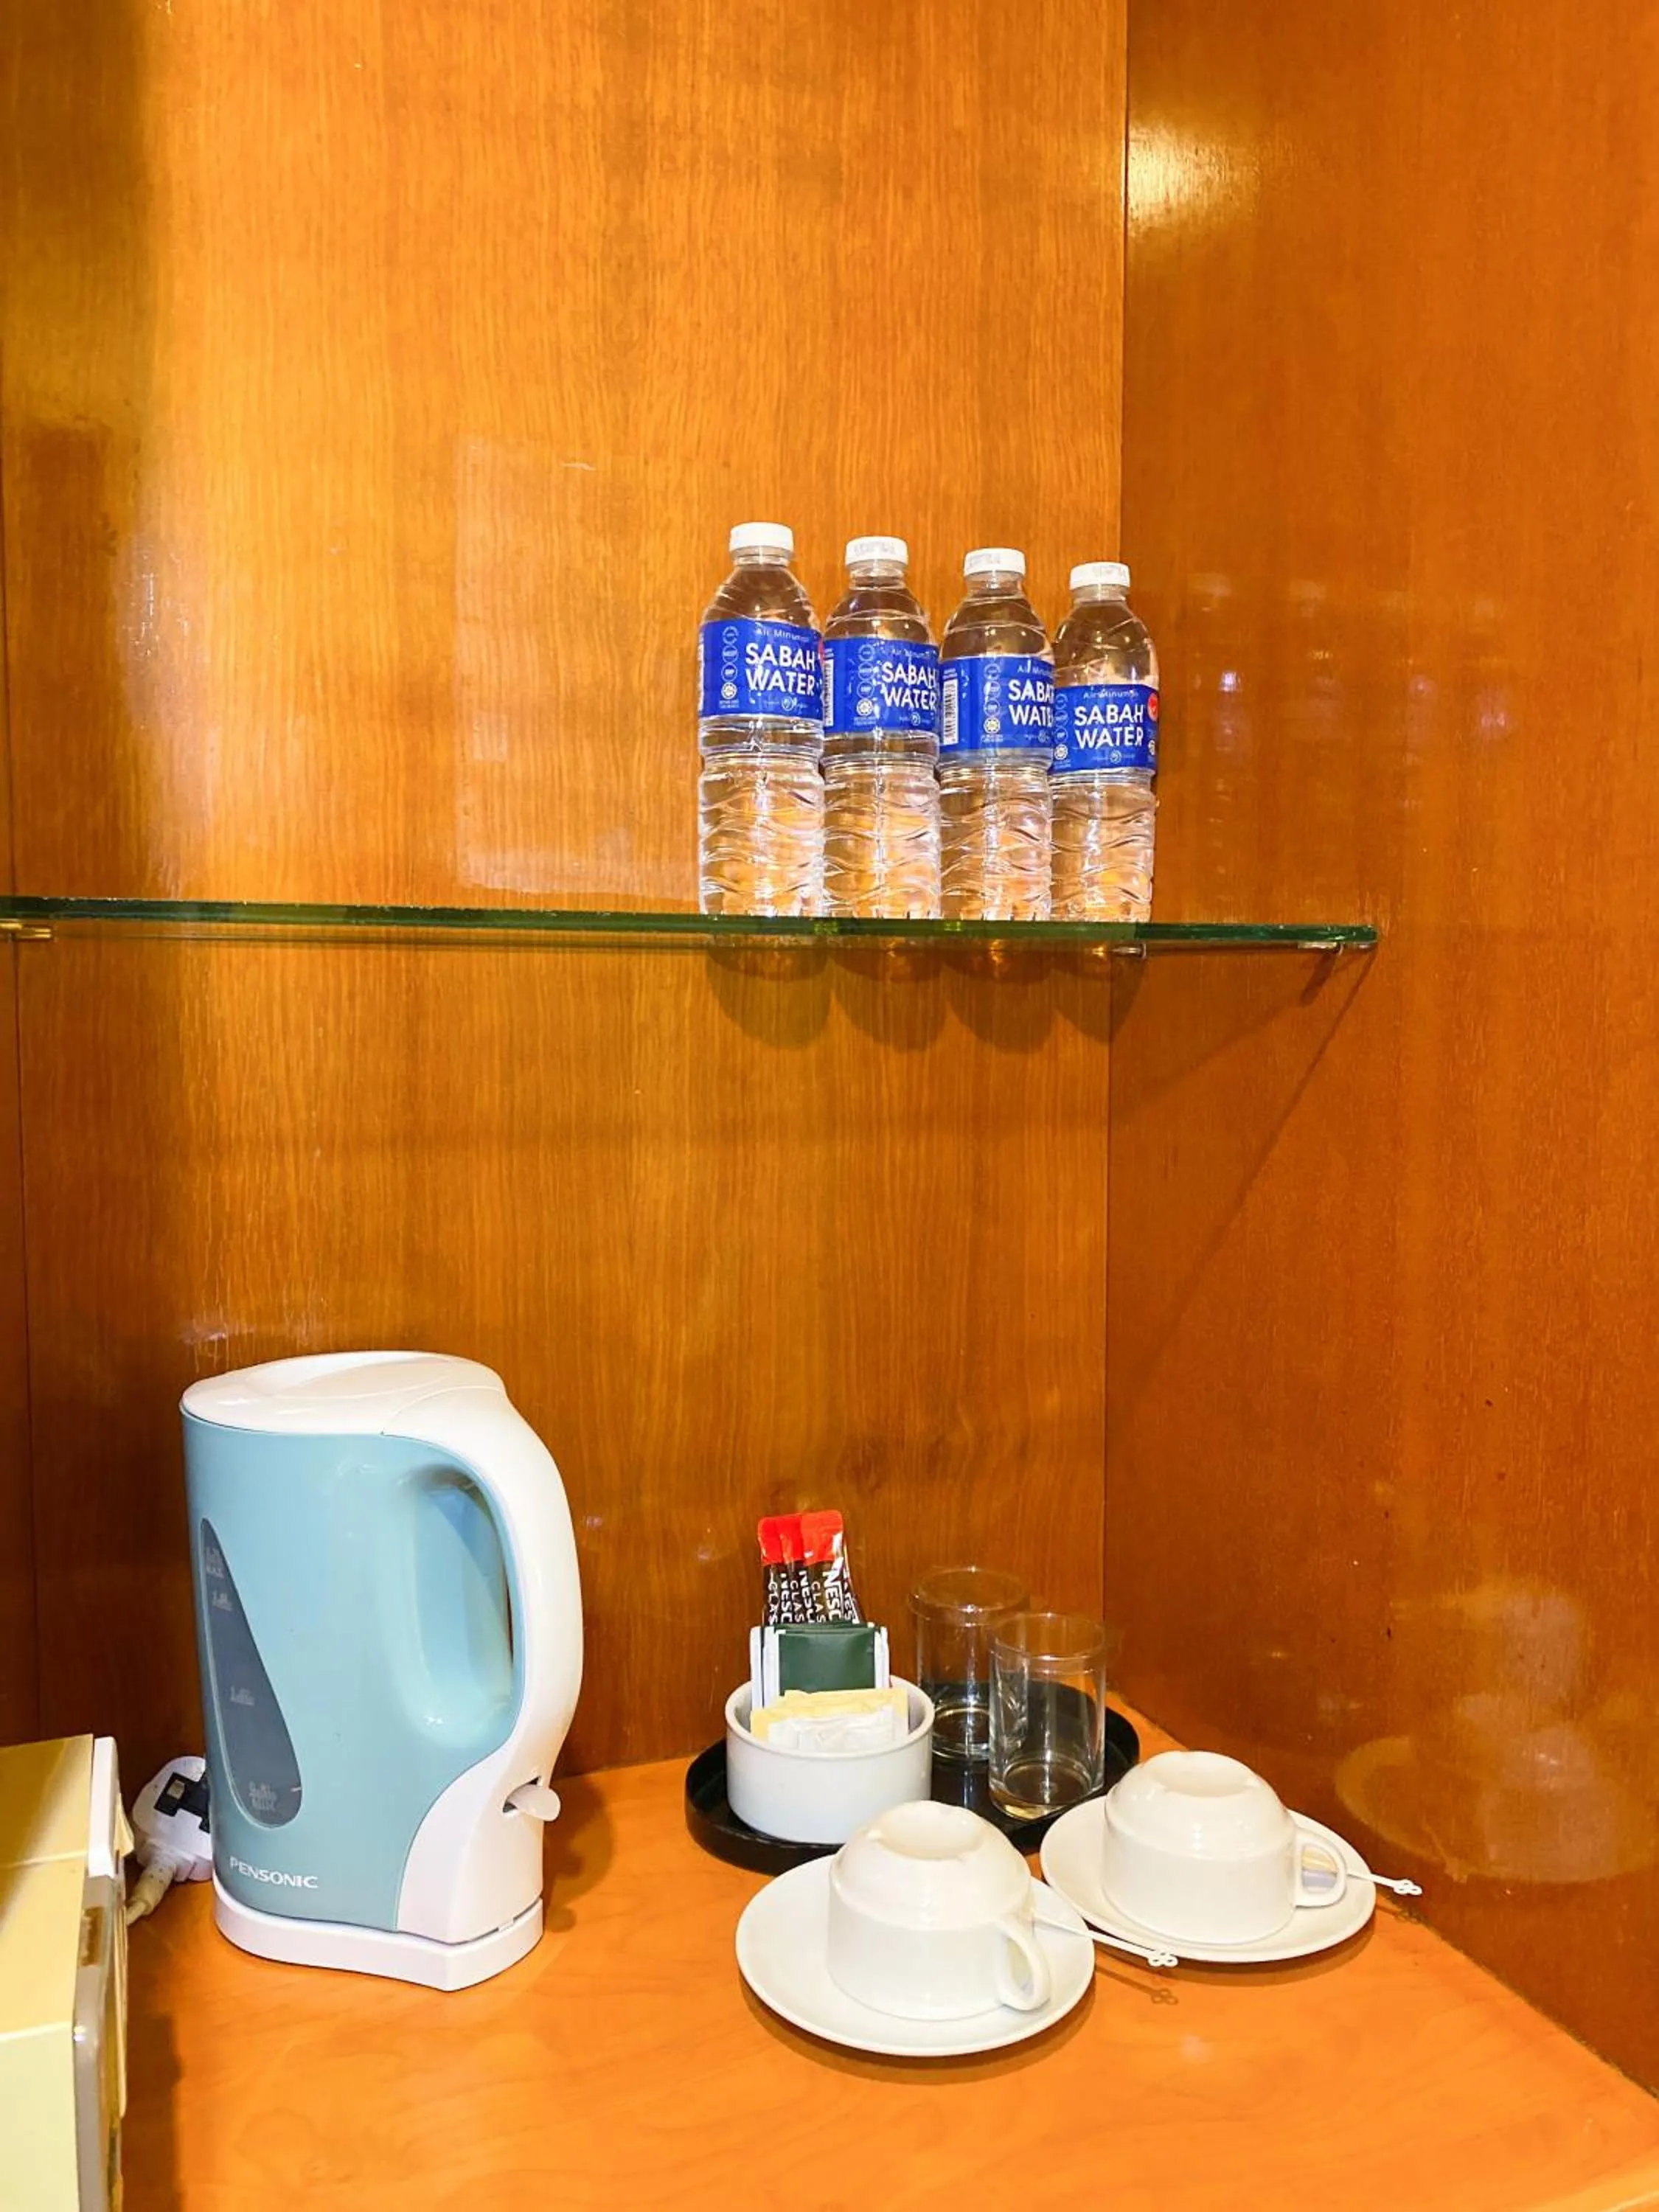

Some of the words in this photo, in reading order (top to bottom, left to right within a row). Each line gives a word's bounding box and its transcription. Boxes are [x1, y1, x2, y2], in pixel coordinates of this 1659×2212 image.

[745, 642, 815, 672] SABAH
[745, 667, 815, 696] WATER
[882, 661, 936, 689] SABAH
[883, 686, 936, 711] WATER
[1008, 704, 1054, 728] WATE
[1074, 703, 1144, 726] SABAH
[1074, 726, 1144, 749] WATER
[790, 1580, 804, 1622] CLAS
[811, 1581, 826, 1622] CLAS
[822, 1557, 844, 1621] NESC
[229, 1855, 319, 1888] PENSONIC
